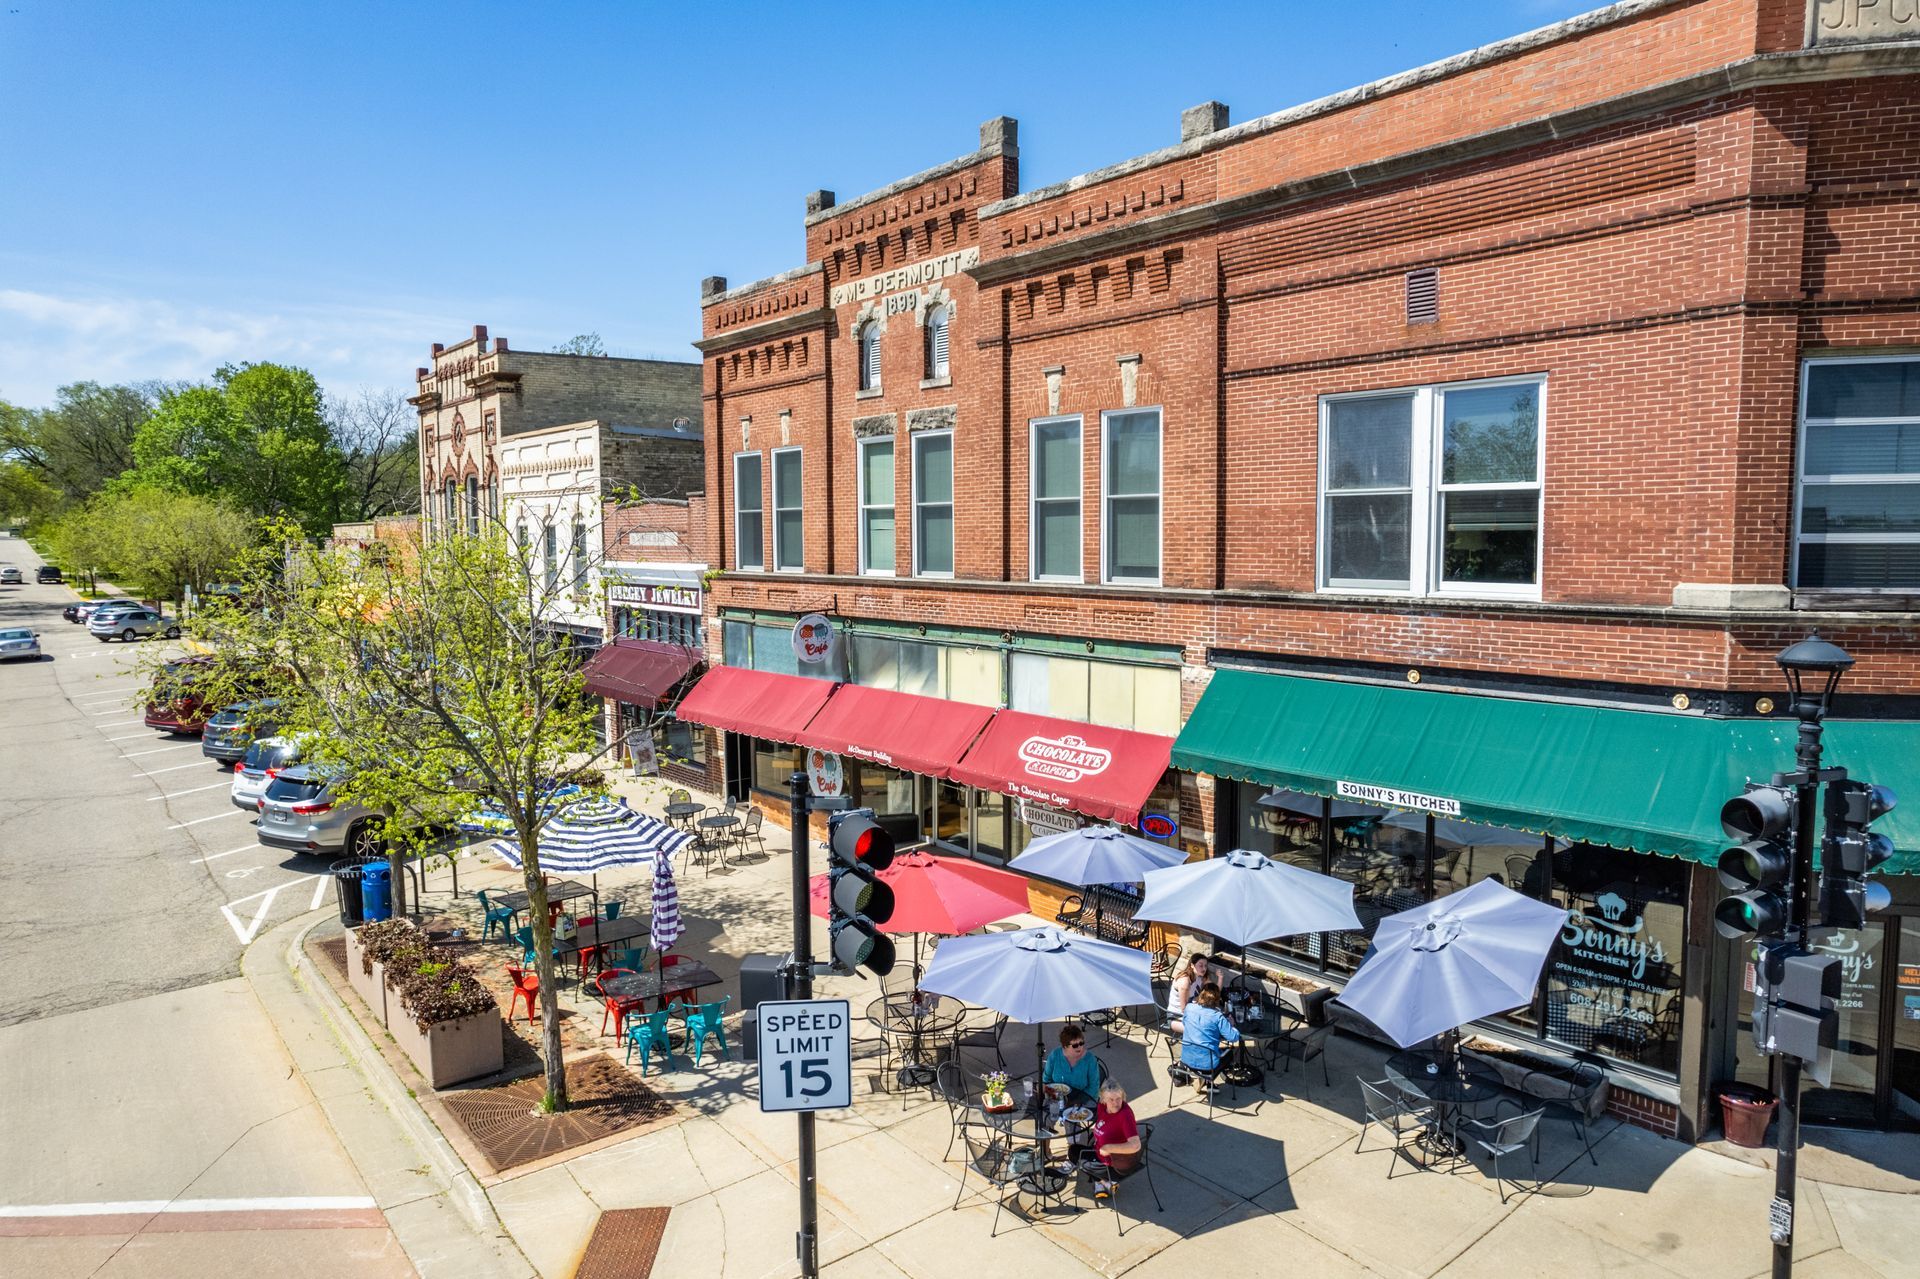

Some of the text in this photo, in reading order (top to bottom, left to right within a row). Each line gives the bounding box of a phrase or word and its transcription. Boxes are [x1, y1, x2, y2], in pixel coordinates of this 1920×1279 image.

[874, 252, 961, 295] DERMOTT
[1026, 742, 1104, 768] CHOCOLATE
[1039, 763, 1067, 777] CAPER
[816, 776, 837, 795] Café
[1008, 782, 1070, 805] The Chocolate Caper
[1342, 783, 1456, 812] SONNY'S KITCHEN
[1024, 808, 1075, 830] CHOCOLATE
[1144, 818, 1173, 836] OPEN
[1561, 908, 1668, 979] Sonny's
[1574, 949, 1629, 968] KITCHEN
[1555, 962, 1573, 972] OPEN
[1628, 980, 1645, 990] DAYS
[767, 1013, 842, 1032] SPEED
[776, 1036, 833, 1054] LIMIT
[780, 1058, 832, 1098] 15
